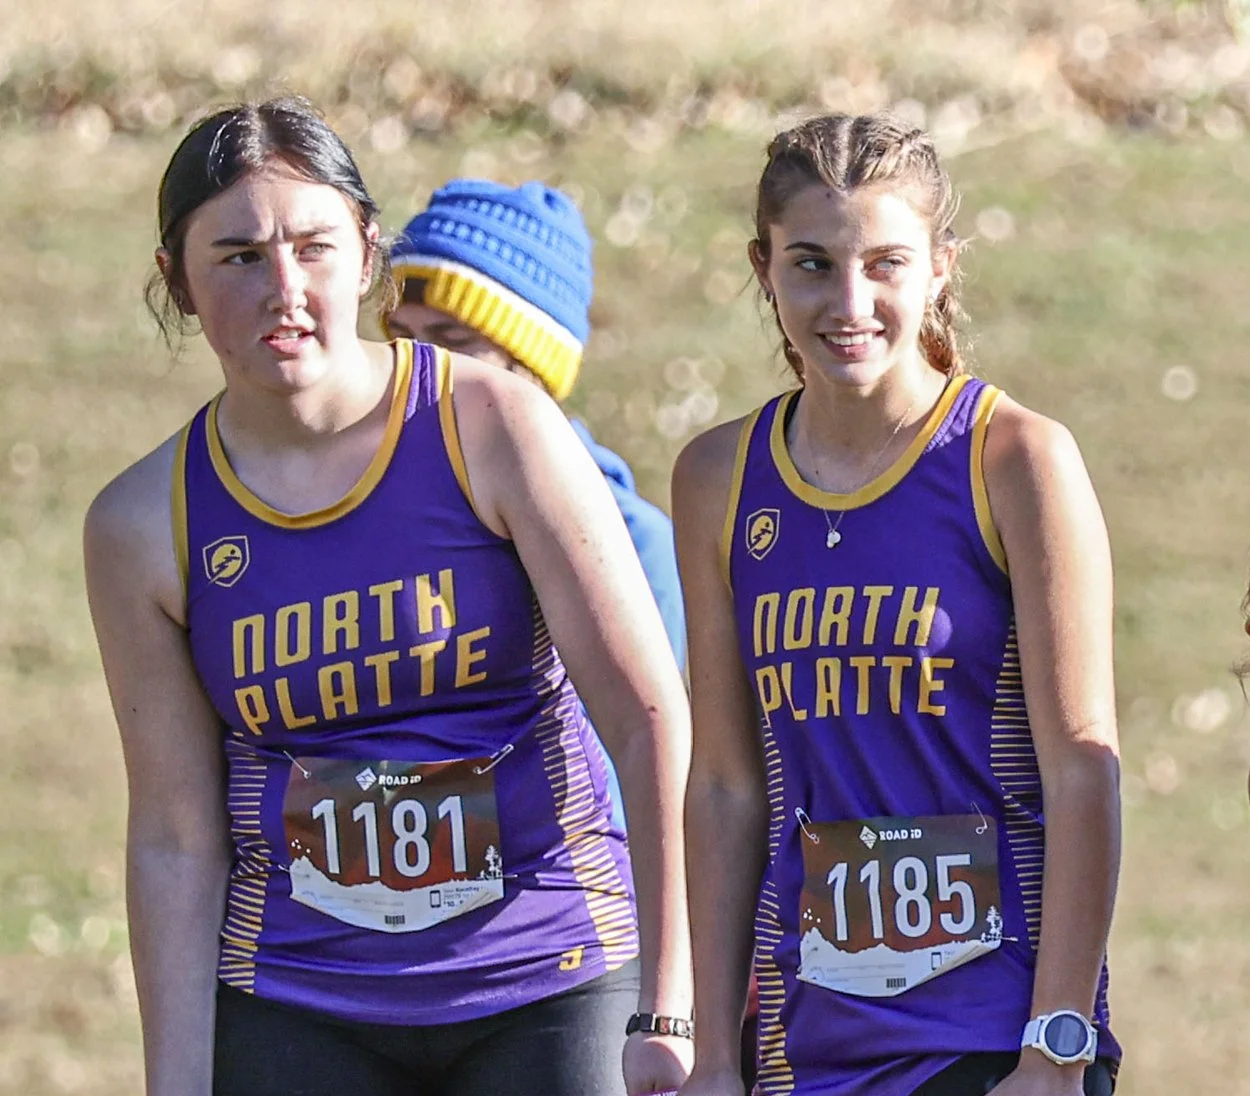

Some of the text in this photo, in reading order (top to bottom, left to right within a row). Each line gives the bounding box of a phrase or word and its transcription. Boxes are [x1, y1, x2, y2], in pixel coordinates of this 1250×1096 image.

[233, 568, 457, 680] NORTH
[753, 585, 940, 657] NORTH
[235, 626, 491, 736] PLATTE
[755, 656, 955, 728] PLATTE
[378, 774, 409, 785] ROAD
[311, 795, 467, 878] 1181
[879, 830, 907, 841] ROAD
[827, 853, 977, 941] 1185
